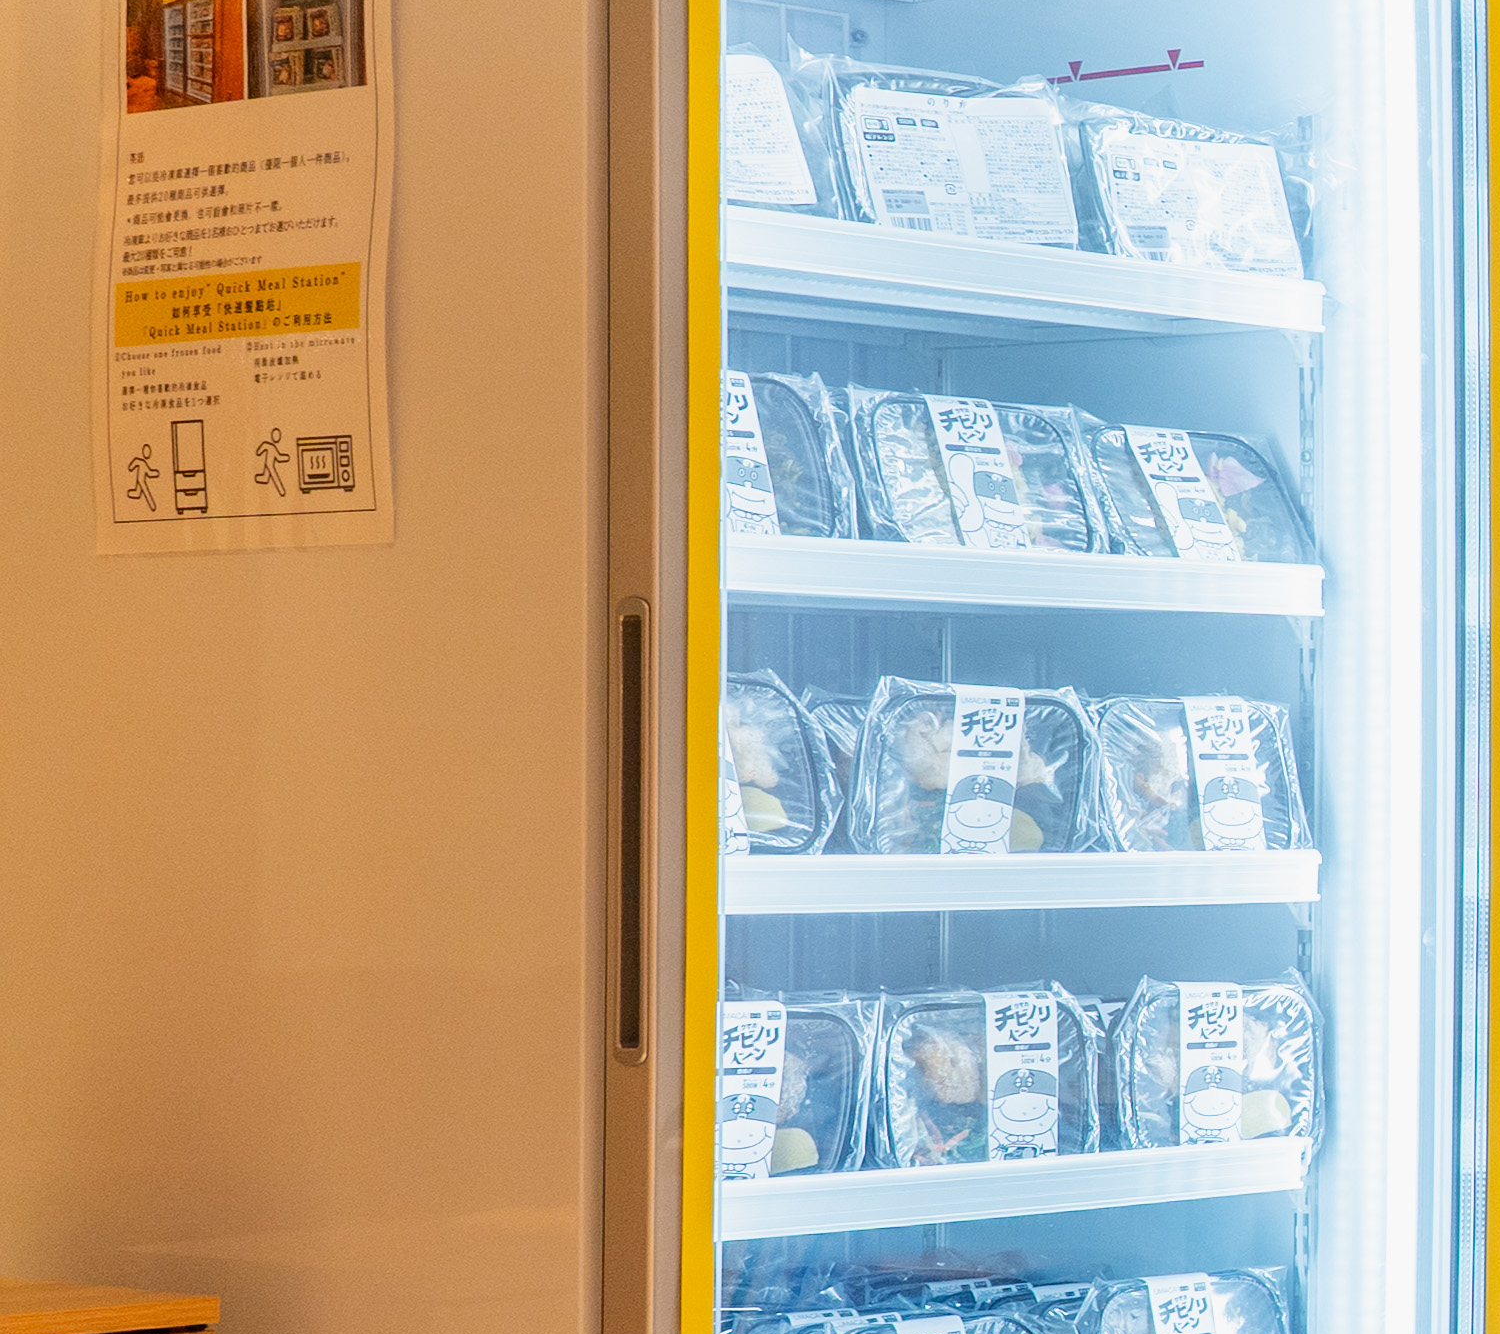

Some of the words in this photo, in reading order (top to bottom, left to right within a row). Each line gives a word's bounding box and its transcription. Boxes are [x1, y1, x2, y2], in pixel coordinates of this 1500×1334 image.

[124, 290, 149, 304] How
[154, 288, 167, 301] to
[216, 278, 252, 295] Quick
[257, 276, 287, 291] Meal
[186, 321, 214, 335] Meal
